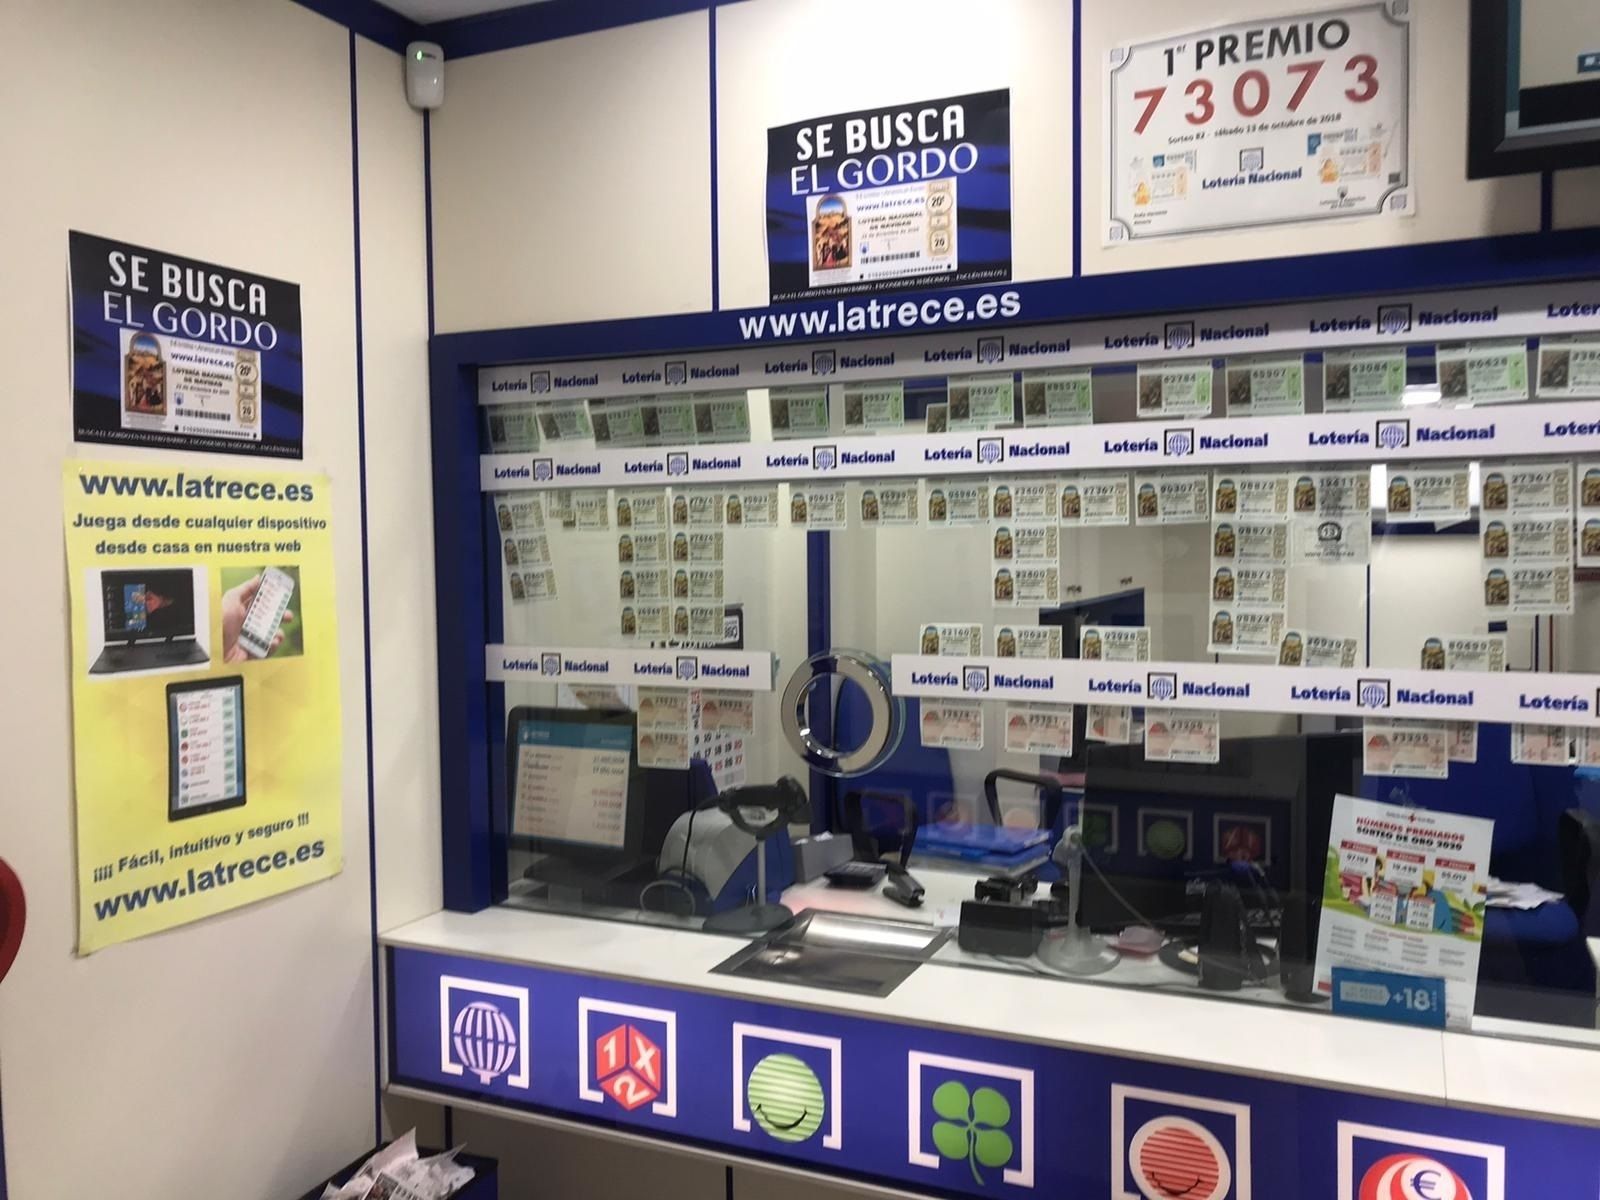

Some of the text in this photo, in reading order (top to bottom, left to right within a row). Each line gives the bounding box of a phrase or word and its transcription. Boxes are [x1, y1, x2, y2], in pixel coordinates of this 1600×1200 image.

[1195, 19, 1350, 72] PREMIO
[1133, 54, 1379, 136] 73073
[796, 104, 965, 161] SE BUSCA
[1168, 134, 1194, 145] Sorteo
[1258, 121, 1269, 131] de
[1270, 117, 1304, 130] octubre
[1306, 116, 1317, 125] de
[790, 142, 978, 196] EL GORDO
[1202, 166, 1302, 190] Lotería Nacional
[108, 251, 266, 317] SE BUSCA
[103, 290, 278, 352] EL GORDO
[739, 291, 1021, 340] www.latrece.es
[1309, 305, 1499, 334] Lotería Nacional
[1104, 322, 1269, 350] Lotería Nacional
[764, 352, 895, 374] Lotería Nacional
[924, 339, 1070, 363] Lotería Nacional
[492, 374, 598, 392] Lotería Nacional
[622, 363, 740, 384] Lotería Nacional
[1104, 433, 1269, 454] Lotería Nacional
[1308, 424, 1495, 446] Lotería Nacional
[766, 450, 895, 468] Lotería Nacional
[924, 441, 1070, 461] Lotería Nacional
[494, 462, 601, 479] Lotería Nacional
[624, 456, 741, 474] Lotería Nacional
[79, 473, 314, 502] www.latrece.es
[73, 513, 327, 533] Juega desde cualquier dispositivo
[96, 540, 301, 555] desde casa en nuestra web
[502, 657, 609, 674] Lotería Nacional
[633, 660, 750, 679] Lotería Nacional
[911, 671, 1054, 690] Lotería Nacional
[1088, 677, 1250, 698] Lotería Nacional
[1290, 684, 1474, 706] Lotería Nacional
[1519, 693, 1589, 711] Lotería
[1356, 815, 1403, 833] NÚMEROS
[1406, 826, 1465, 842] PREMIADOS
[1356, 825, 1393, 841] SORTEO
[1395, 832, 1409, 843] DE
[1411, 834, 1434, 847] ORO
[1436, 839, 1463, 852] 2020
[118, 849, 164, 874] Fácil,
[169, 833, 231, 860] intuitivo
[236, 830, 244, 846] y
[247, 817, 294, 841] seguro
[93, 839, 325, 921] www.latrece.es
[1392, 987, 1431, 1012] +18
